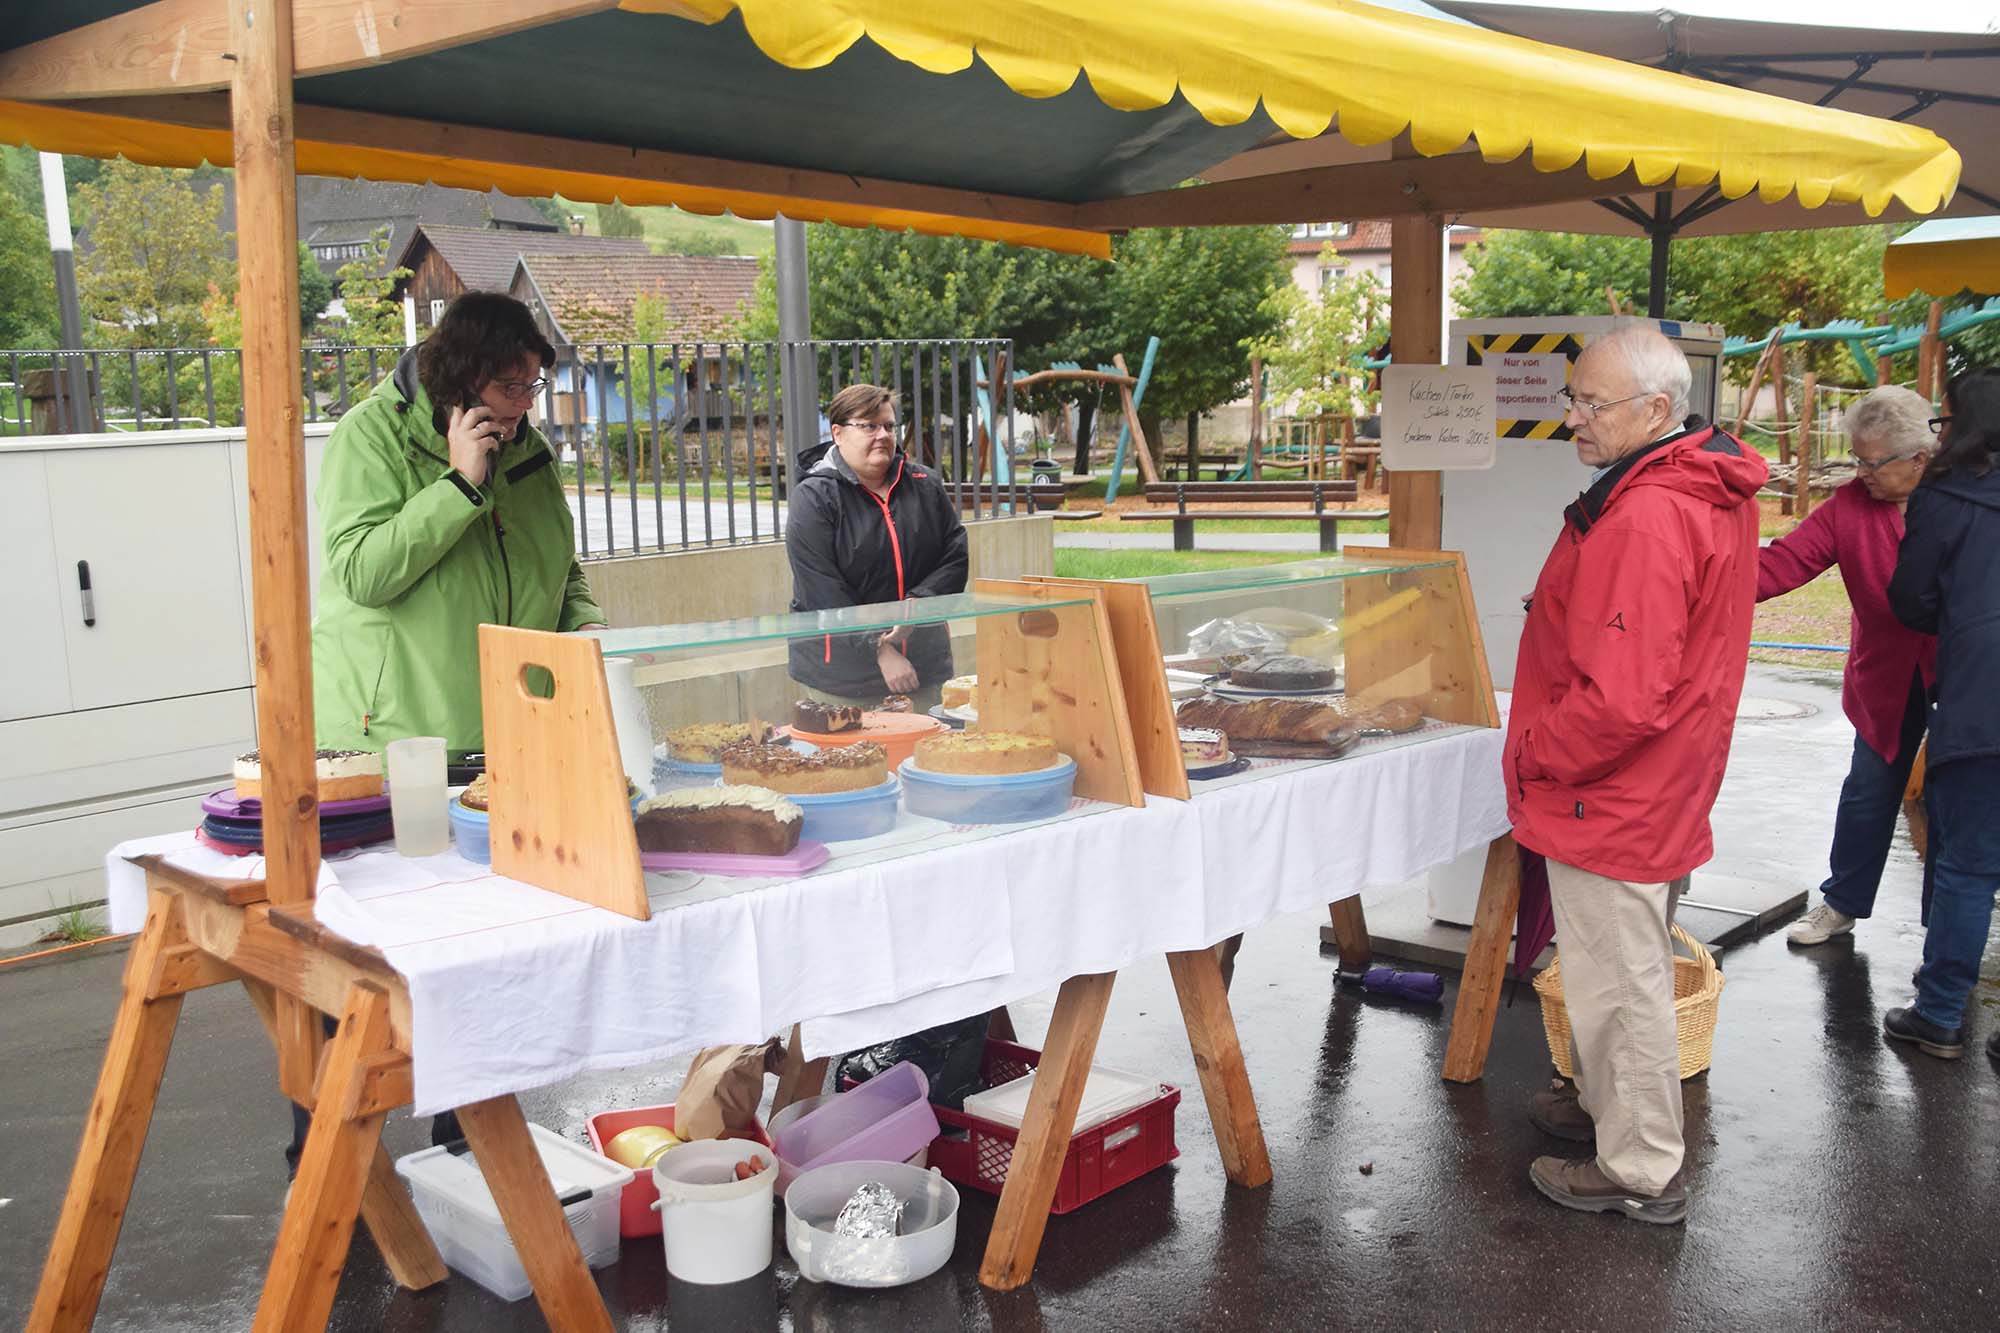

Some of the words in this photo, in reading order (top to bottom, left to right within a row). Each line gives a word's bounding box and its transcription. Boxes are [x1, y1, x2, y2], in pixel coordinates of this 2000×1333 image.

[1503, 358, 1520, 367] Nur
[1525, 376, 1548, 385] Seite
[1496, 395, 1548, 405] nsportieren
